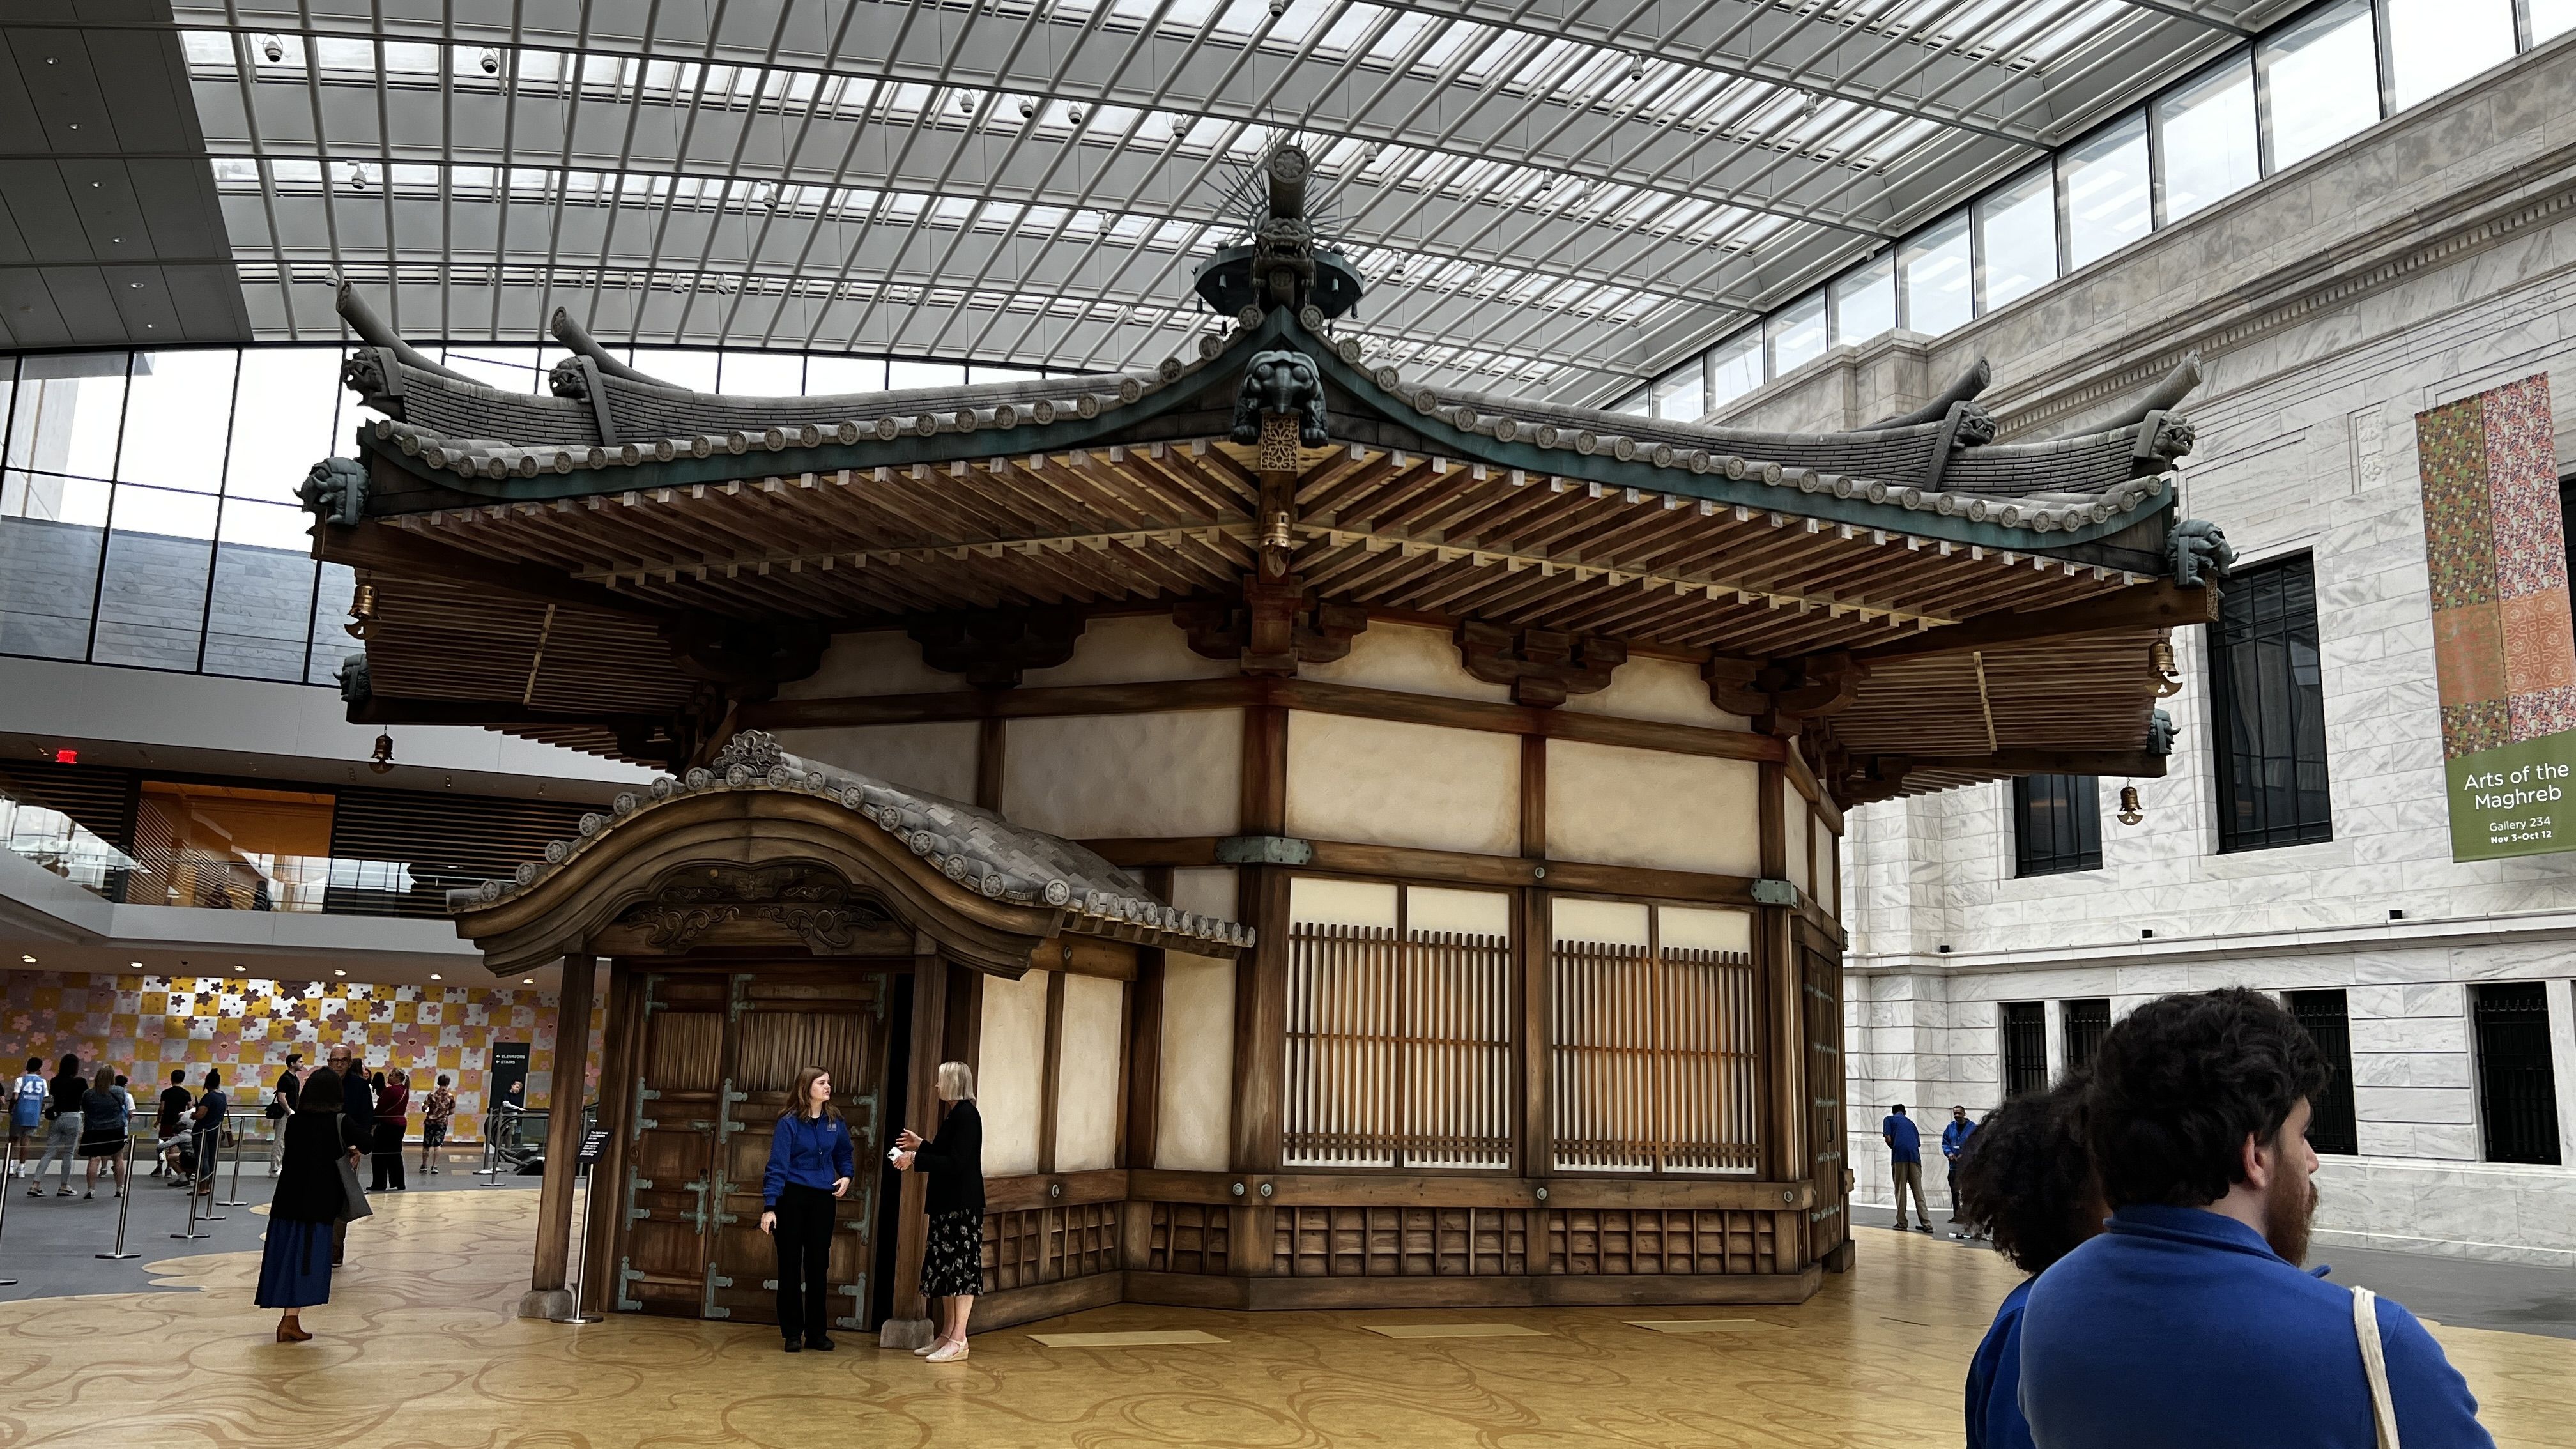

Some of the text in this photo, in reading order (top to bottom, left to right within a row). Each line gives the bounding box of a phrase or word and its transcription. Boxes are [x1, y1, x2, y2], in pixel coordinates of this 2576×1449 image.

[2464, 763, 2570, 791] Arts of the
[2475, 785, 2562, 810] Maghreb
[2489, 816, 2551, 832] Gallery 234
[2490, 836, 2509, 844] Nov
[23, 1081, 43, 1093] 45
